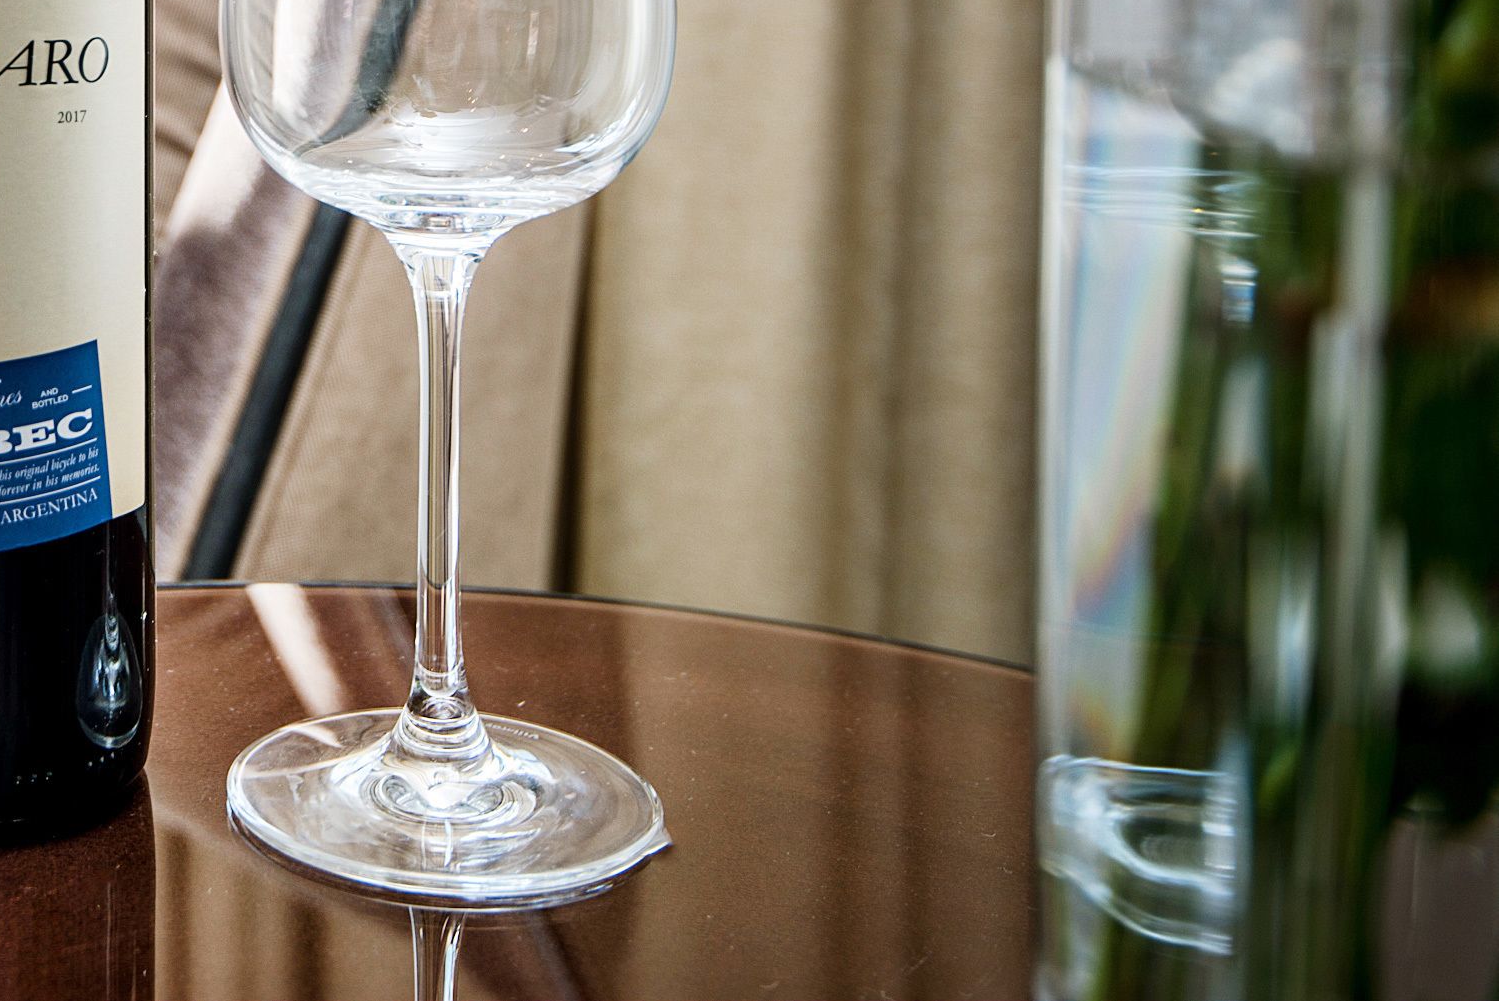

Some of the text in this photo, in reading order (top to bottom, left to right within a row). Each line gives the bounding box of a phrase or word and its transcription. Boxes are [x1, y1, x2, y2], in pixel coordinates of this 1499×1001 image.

[57, 109, 87, 124] 2017
[31, 394, 69, 410] BOTTLED
[40, 387, 59, 398] AND
[0, 469, 12, 481] his
[15, 460, 49, 479] original
[51, 453, 76, 472] bicycle
[78, 453, 86, 463] to
[88, 446, 99, 459] his
[32, 478, 42, 488] in
[45, 474, 58, 488] his
[61, 463, 100, 484] memories.
[1, 487, 98, 524] ARGENTINA
